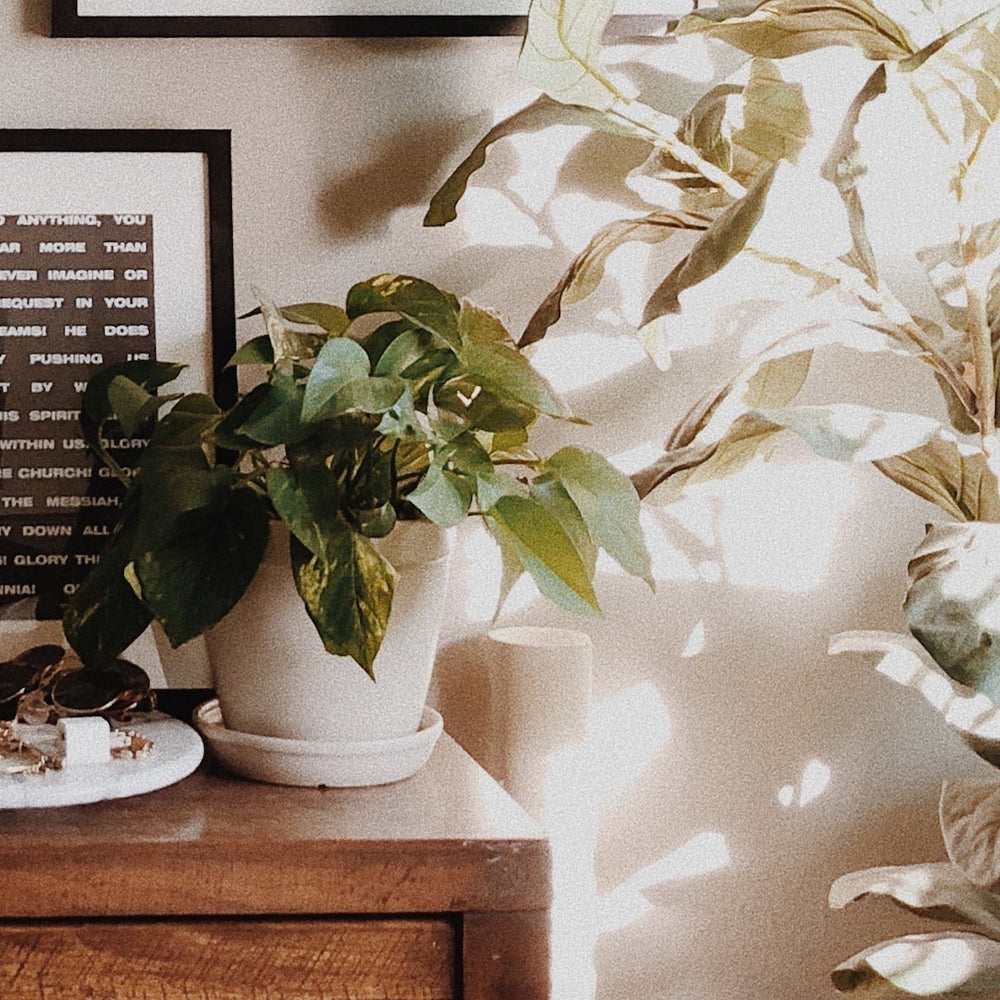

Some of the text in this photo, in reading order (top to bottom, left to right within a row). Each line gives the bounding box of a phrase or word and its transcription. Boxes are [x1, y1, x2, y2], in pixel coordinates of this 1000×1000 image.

[17, 214, 102, 228] ANYTHING,
[114, 214, 146, 227] YOU
[40, 242, 87, 253] MORE
[104, 241, 147, 253] THAN
[48, 269, 115, 281] IMAGINE
[124, 269, 148, 281] OR
[76, 297, 93, 309] IN
[104, 297, 149, 309] YOUR
[65, 325, 87, 337] HE
[105, 324, 150, 337] DOES
[30, 353, 104, 365] PUSHING
[31, 382, 54, 393] BY
[29, 410, 81, 422] SPIRIT
[0, 439, 55, 450] WITHIN
[19, 467, 94, 479] CHURCH!
[1, 496, 34, 508] THE
[47, 496, 123, 509] MESSIAH,
[23, 525, 73, 537] DOWN
[83, 525, 110, 536] ALL
[14, 554, 70, 566] GLORY
